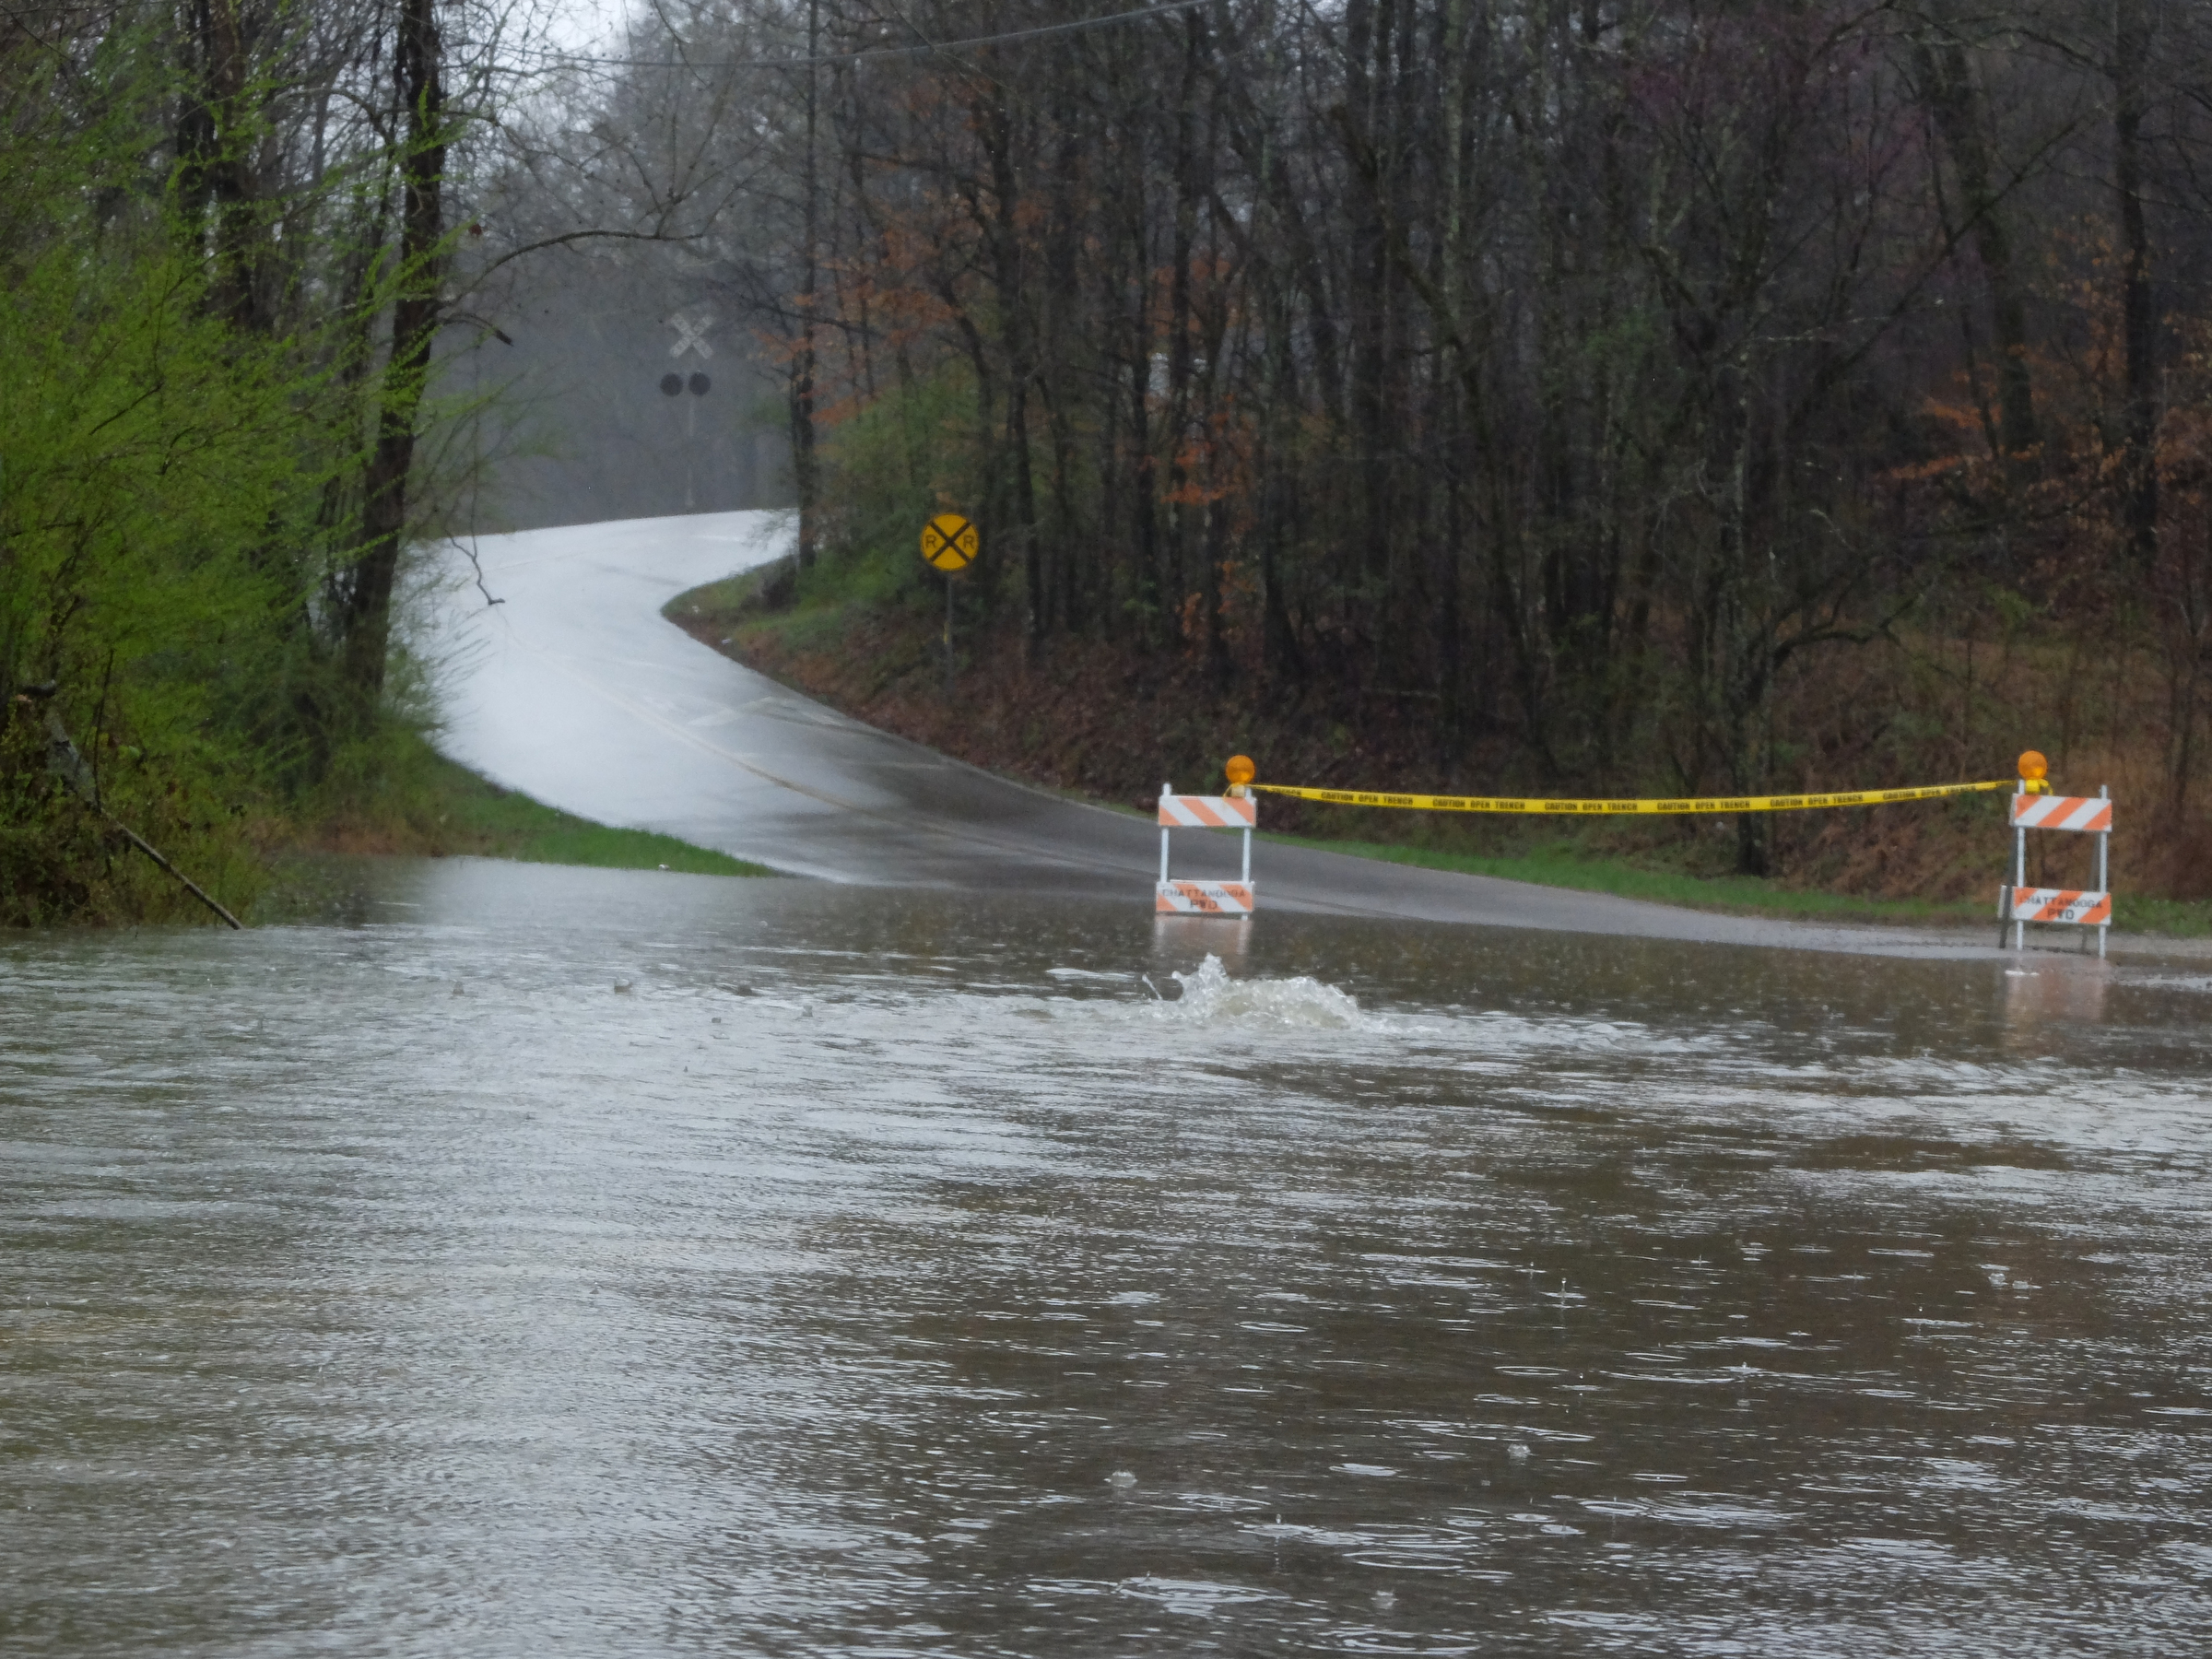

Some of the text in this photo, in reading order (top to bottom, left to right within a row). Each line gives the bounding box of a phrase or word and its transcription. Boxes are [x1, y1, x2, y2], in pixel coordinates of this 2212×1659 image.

[1321, 792, 1354, 802] CAUTION
[1383, 796, 1413, 806] TRENCH
[1883, 791, 1916, 799] CAUTION
[1432, 798, 1525, 809] CAUTION OPEN TRENCH
[1657, 800, 1750, 810] CAUTION OPEN TRENCH
[1770, 798, 1803, 807] CAUTION
[1832, 794, 1863, 804] TRENCH
[1545, 802, 1638, 811] CAUTION OPEN TRENCH
